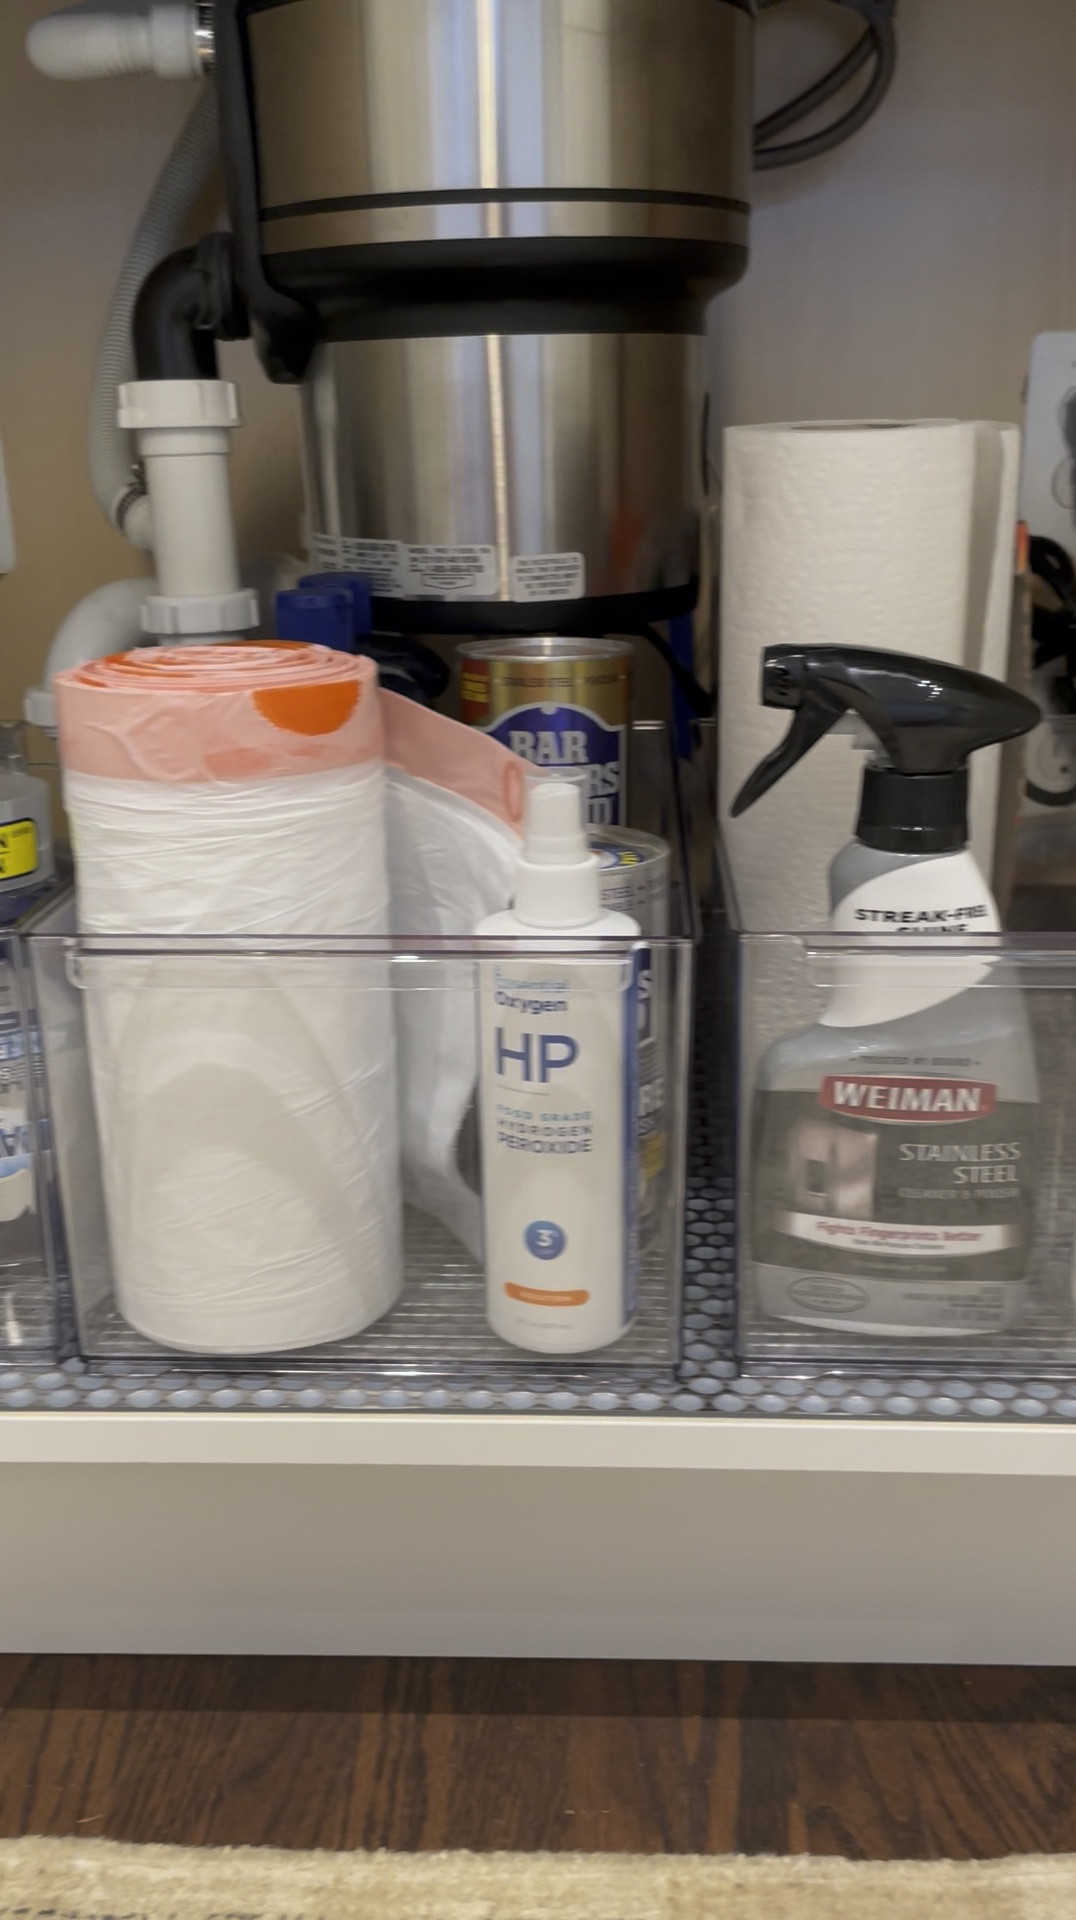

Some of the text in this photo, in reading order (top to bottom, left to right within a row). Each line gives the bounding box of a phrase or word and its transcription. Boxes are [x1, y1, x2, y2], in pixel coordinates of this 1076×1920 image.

[509, 730, 589, 764] BAR
[494, 990, 568, 1015] Oxygen
[494, 1026, 580, 1083] HP
[832, 1081, 982, 1113] WEIMAN
[496, 1103, 593, 1122] FOOD GRADE
[496, 1118, 594, 1137] HYDROGEN
[496, 1131, 593, 1155] PEROXIDE
[899, 1142, 1021, 1162] STAINLESS
[953, 1165, 1019, 1184] STEEL
[815, 1221, 983, 1242] Fights Fingerprints Better
